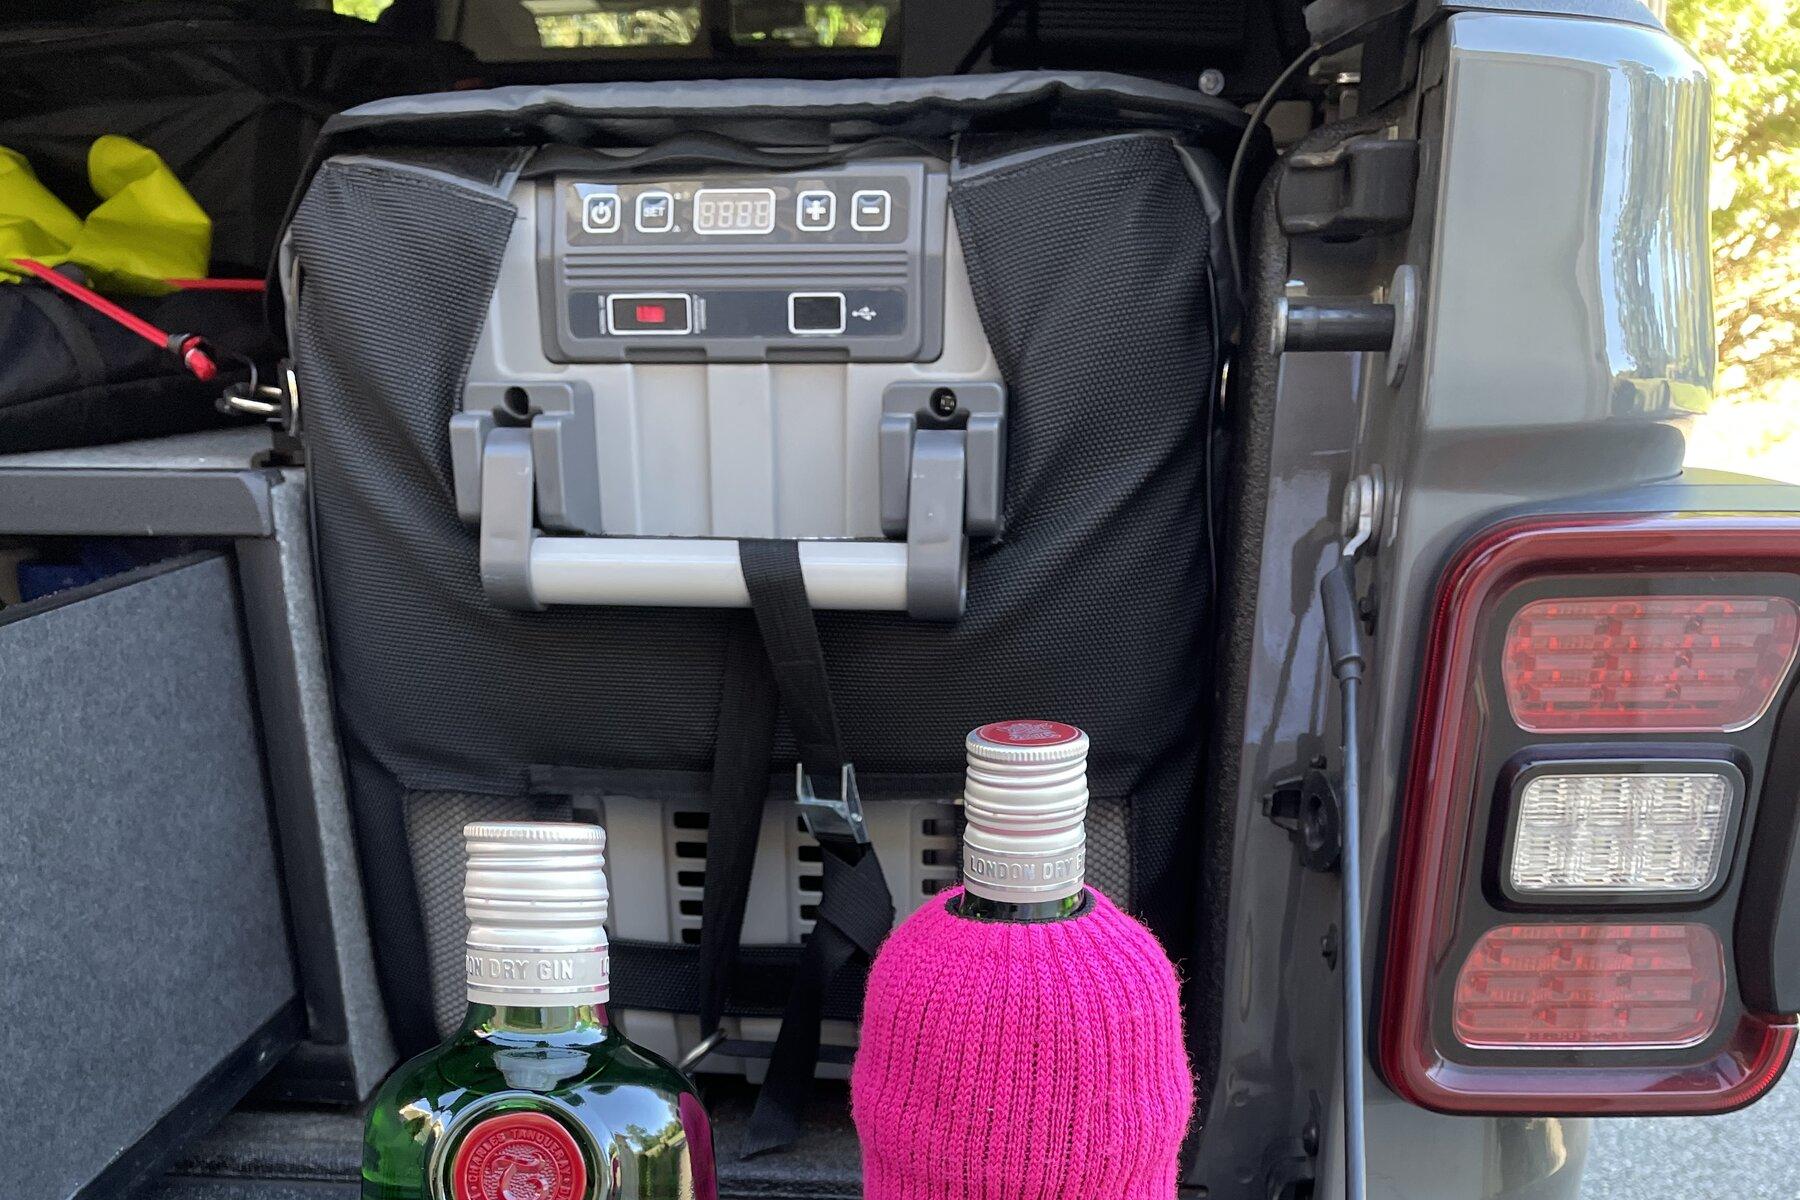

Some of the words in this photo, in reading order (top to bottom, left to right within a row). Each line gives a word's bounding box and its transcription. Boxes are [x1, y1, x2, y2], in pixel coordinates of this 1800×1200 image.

[970, 855, 1036, 880] LONDON
[1043, 858, 1074, 880] DRY
[489, 958, 529, 979] DRY
[537, 960, 574, 981] GIN
[511, 1128, 571, 1176] TANQUERAY
